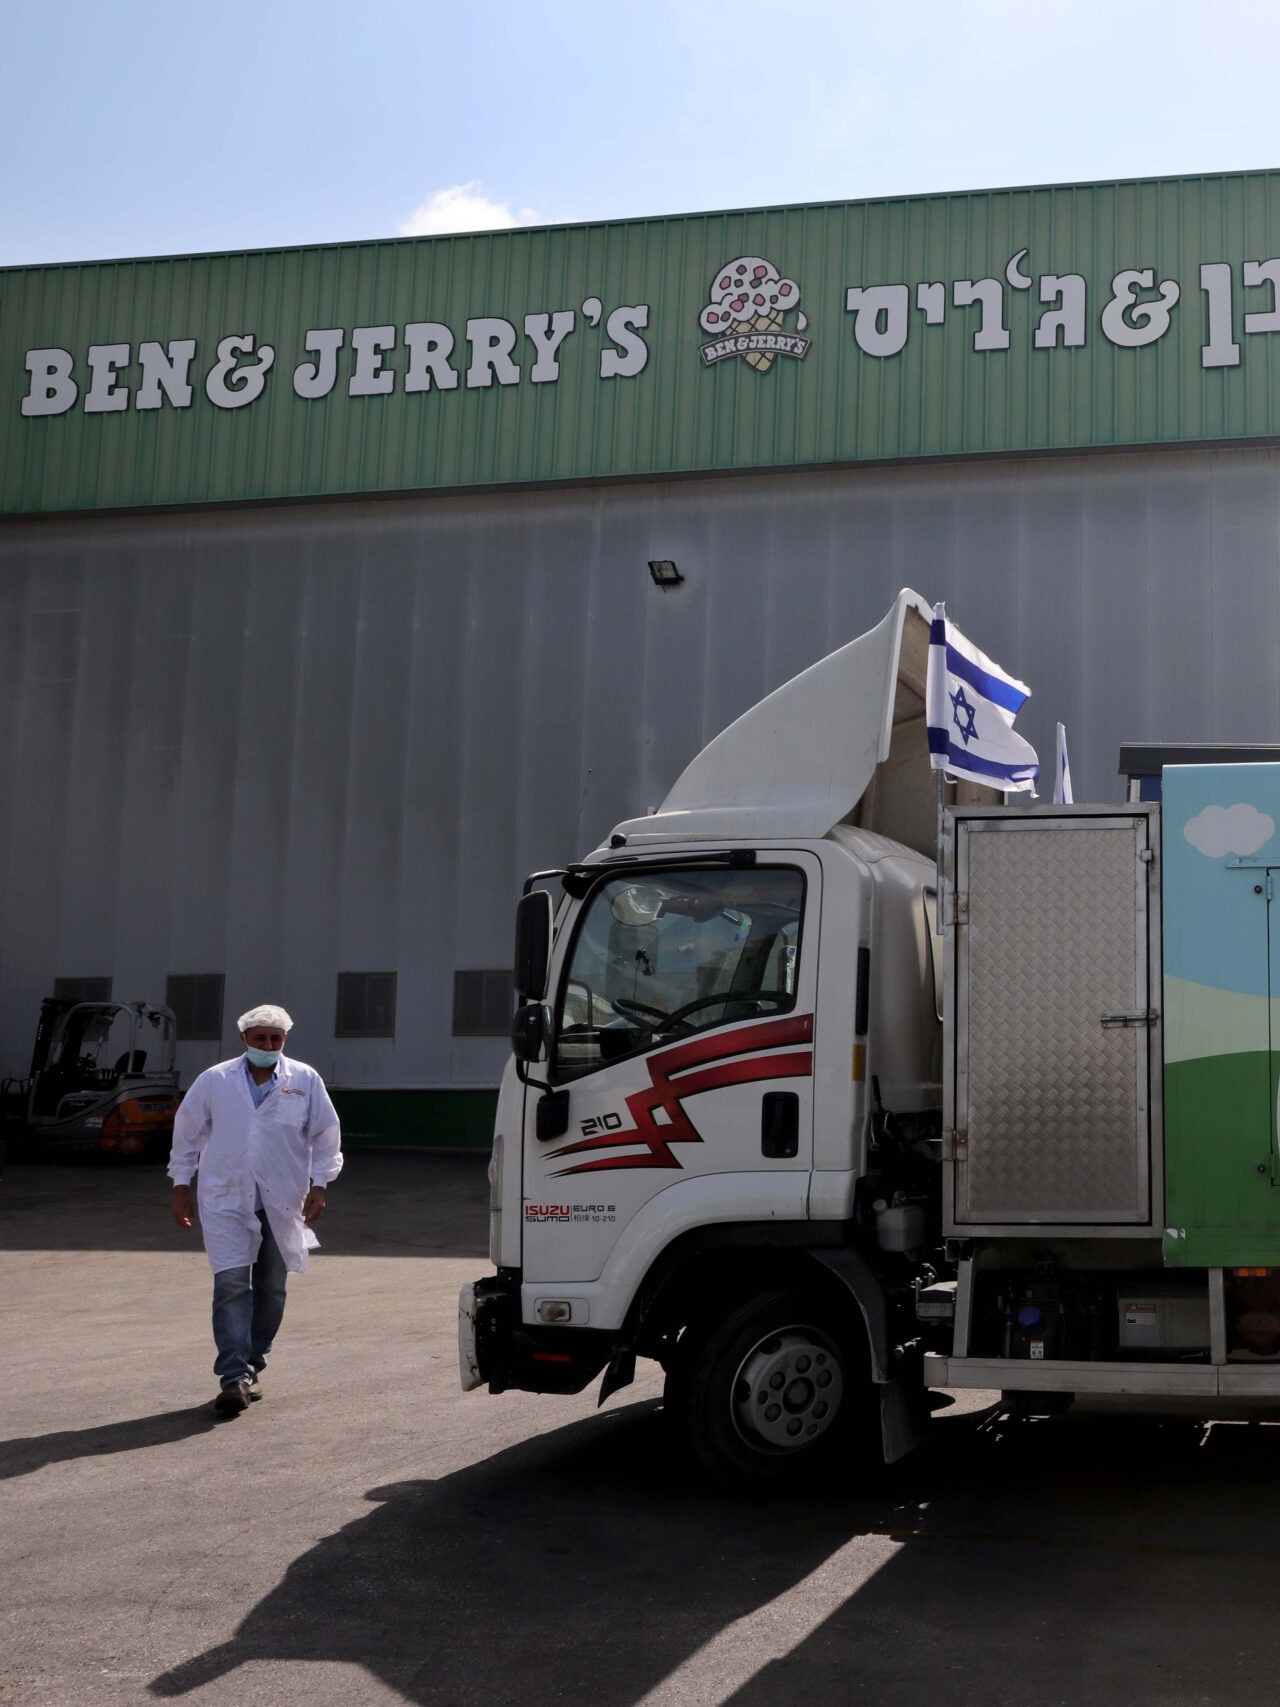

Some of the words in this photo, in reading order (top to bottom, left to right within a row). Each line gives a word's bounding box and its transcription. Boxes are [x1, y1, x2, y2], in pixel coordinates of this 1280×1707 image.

[20, 339, 197, 417] BEN
[292, 296, 649, 399] JERRY'S
[580, 1112, 623, 1137] 210
[525, 1205, 570, 1216] ISUZU
[573, 1205, 605, 1213] EURO
[592, 1215, 616, 1223] 10-210
